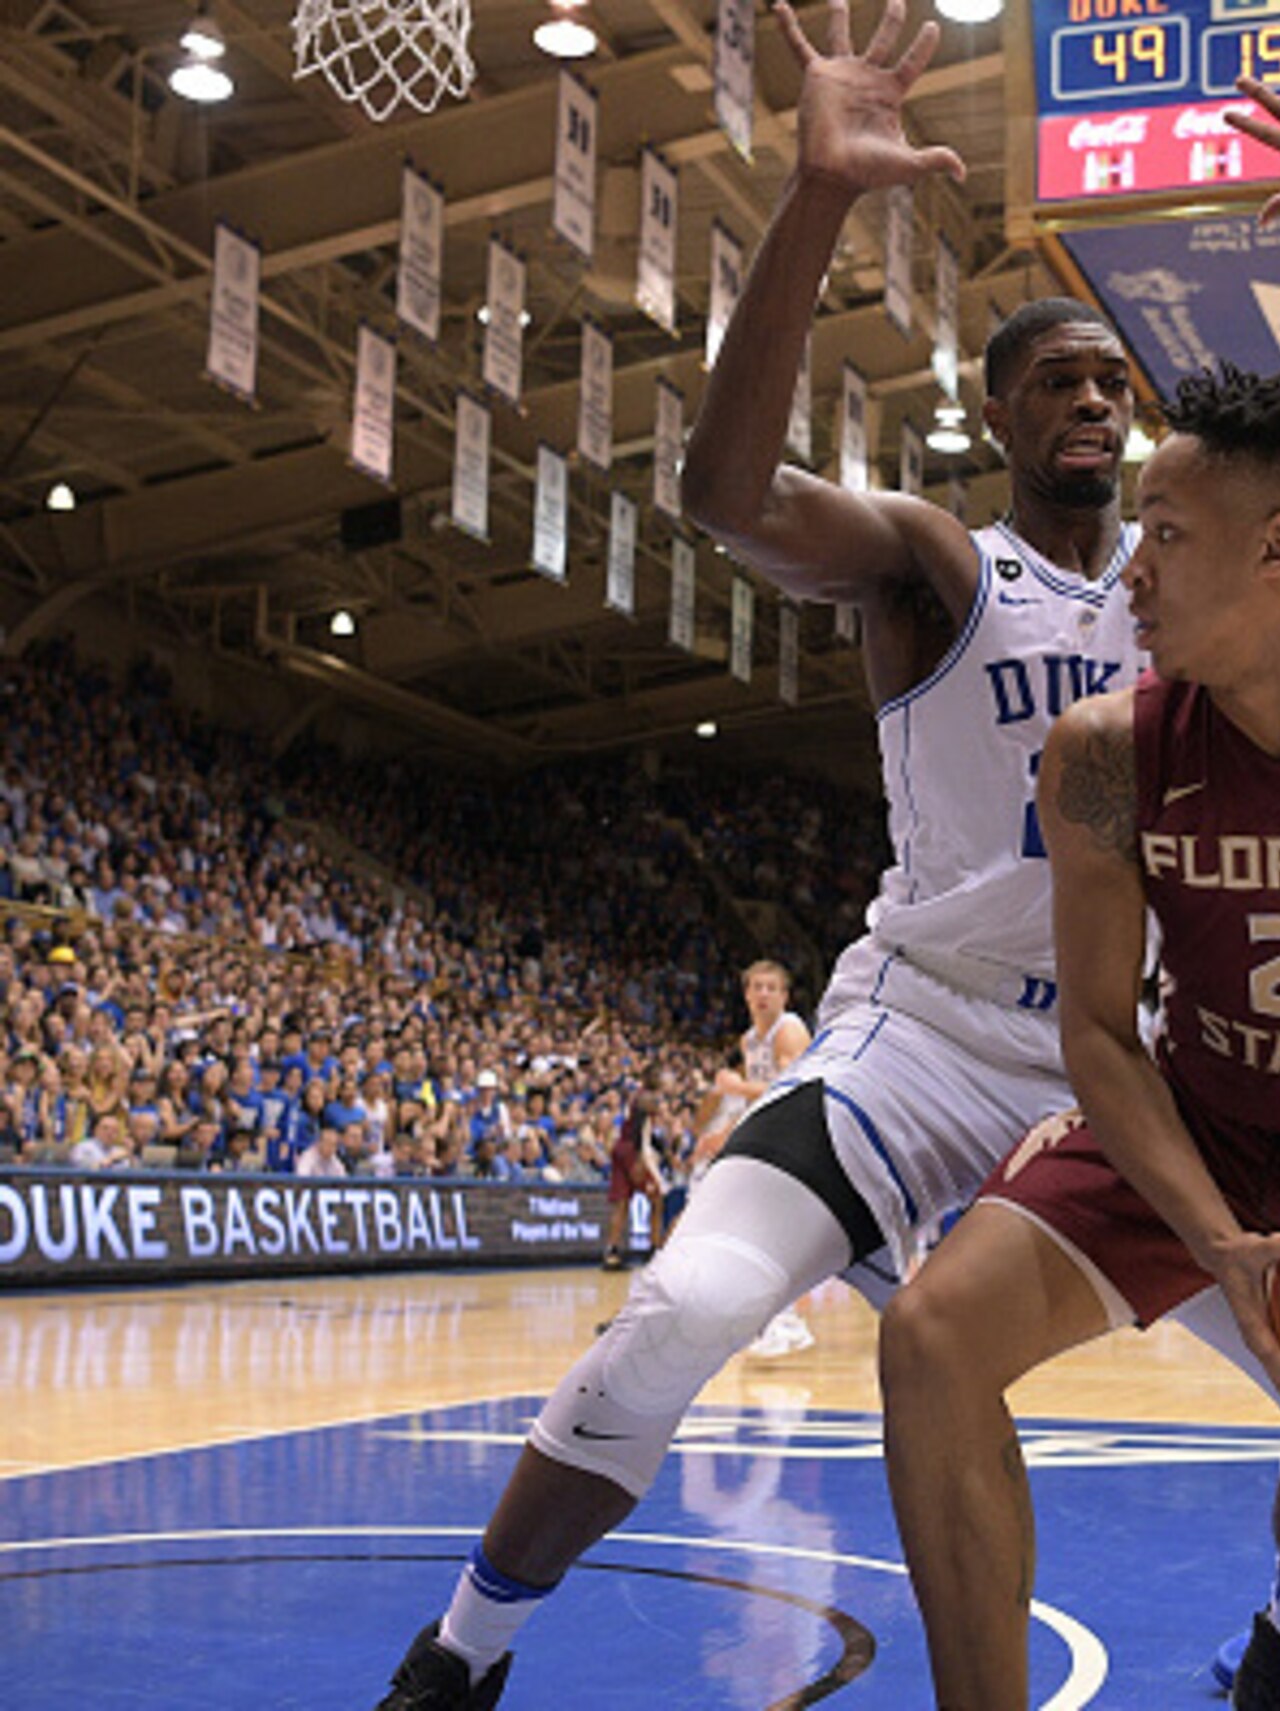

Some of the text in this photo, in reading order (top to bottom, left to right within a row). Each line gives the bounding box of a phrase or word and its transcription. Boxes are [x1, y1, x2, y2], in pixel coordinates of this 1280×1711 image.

[1092, 25, 1166, 83] 49
[984, 654, 1145, 725] DUK
[0, 1184, 482, 1263] DUKE BASKETBALL
